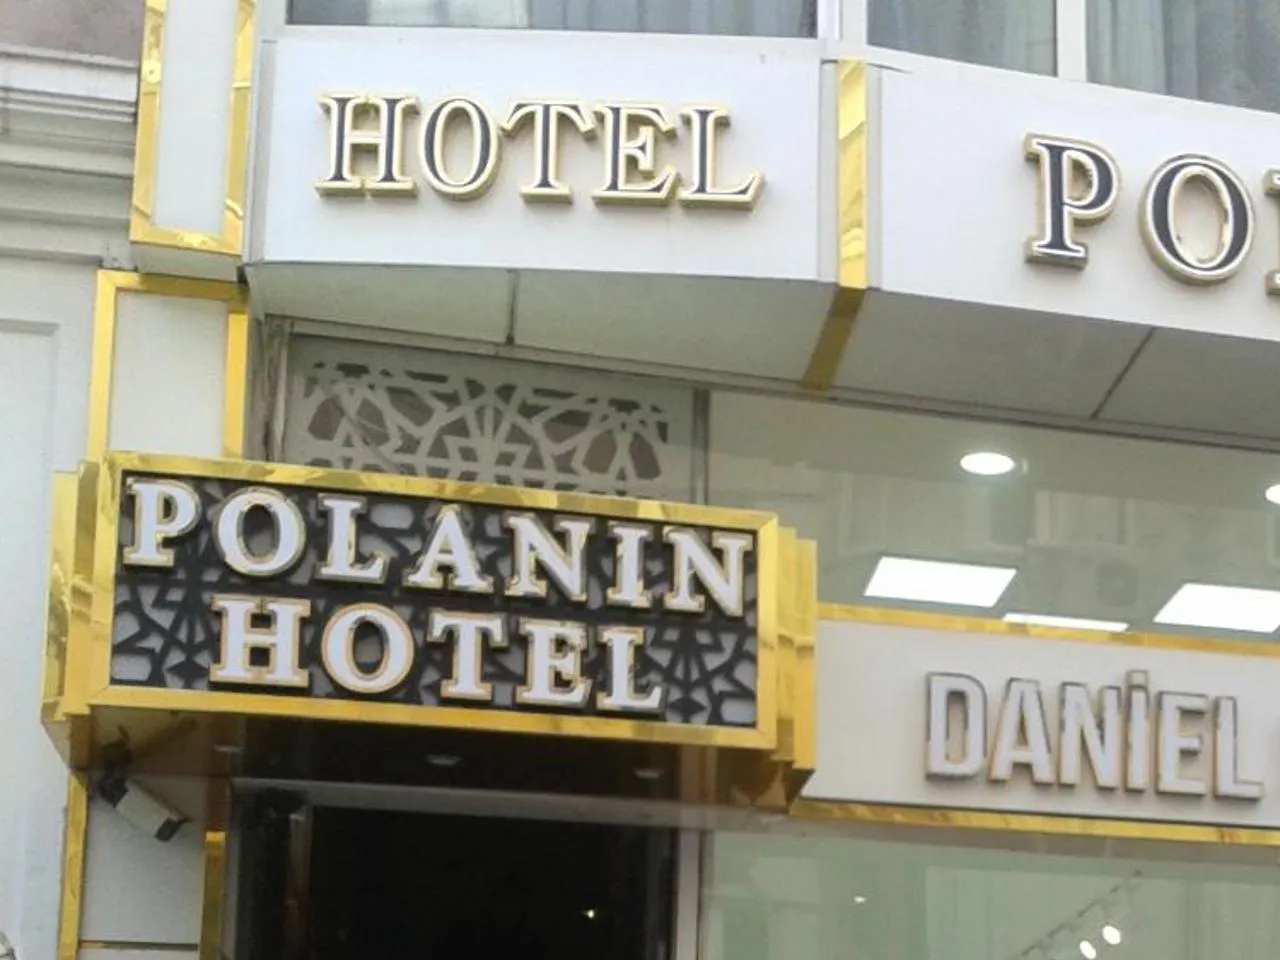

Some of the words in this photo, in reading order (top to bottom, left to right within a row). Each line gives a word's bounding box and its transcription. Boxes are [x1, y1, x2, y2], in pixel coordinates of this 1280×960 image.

[315, 93, 766, 211] HOTEL
[123, 477, 753, 617] POLANIN
[208, 594, 664, 710] HOTEL
